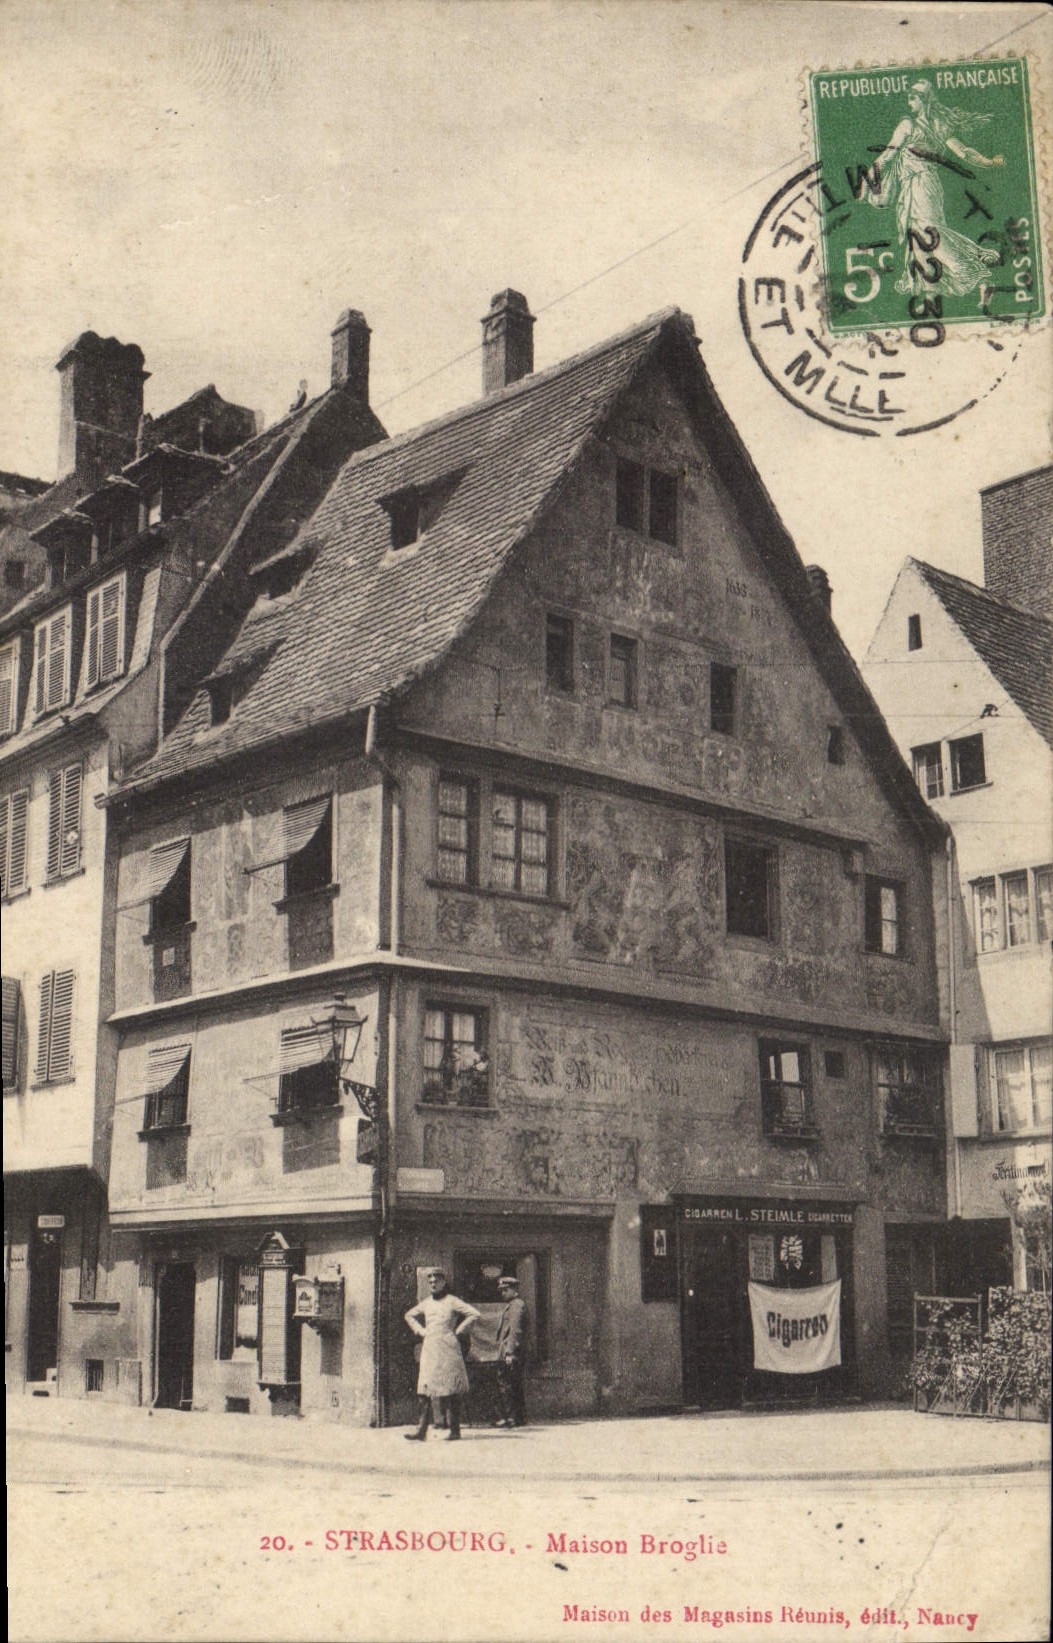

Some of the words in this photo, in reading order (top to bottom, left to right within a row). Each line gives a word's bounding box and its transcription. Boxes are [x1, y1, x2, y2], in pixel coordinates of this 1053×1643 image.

[936, 66, 1019, 92] FRANÇAISE
[750, 1209, 805, 1223] STEIMLE
[766, 1311, 829, 1348] Cigarren
